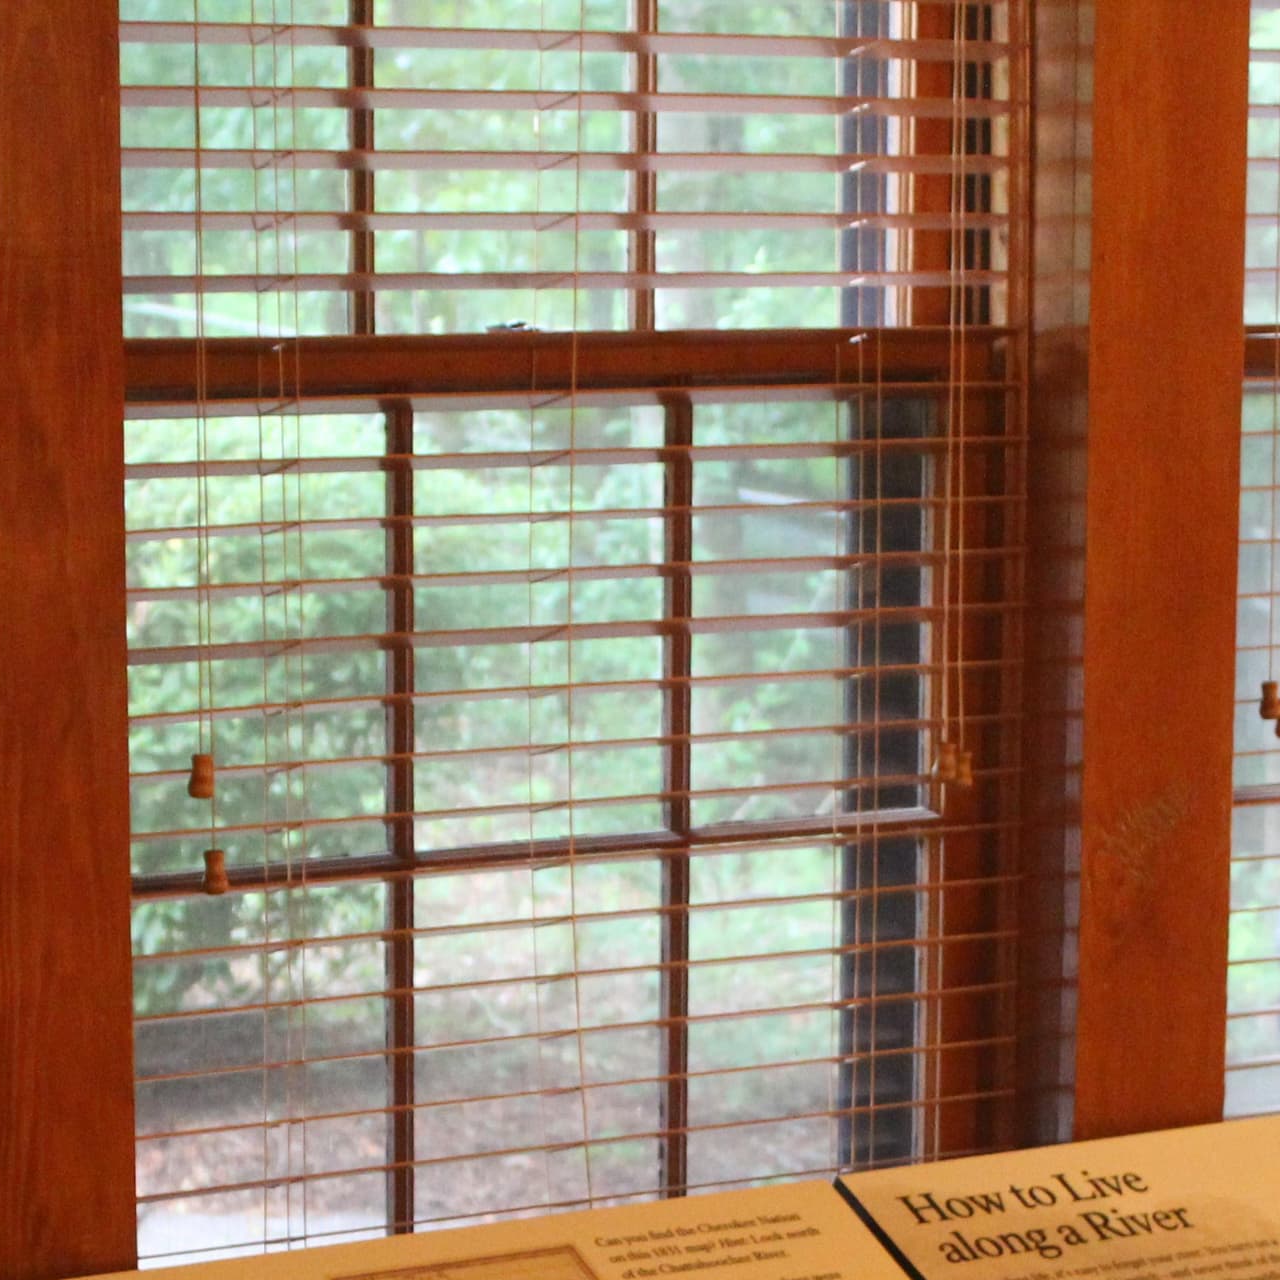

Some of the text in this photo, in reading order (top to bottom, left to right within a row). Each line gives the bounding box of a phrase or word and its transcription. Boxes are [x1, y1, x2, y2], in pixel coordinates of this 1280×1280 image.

[894, 1169, 1149, 1225] How to Live
[937, 1227, 1064, 1265] along
[1054, 1223, 1089, 1247] a
[1076, 1206, 1195, 1242] River
